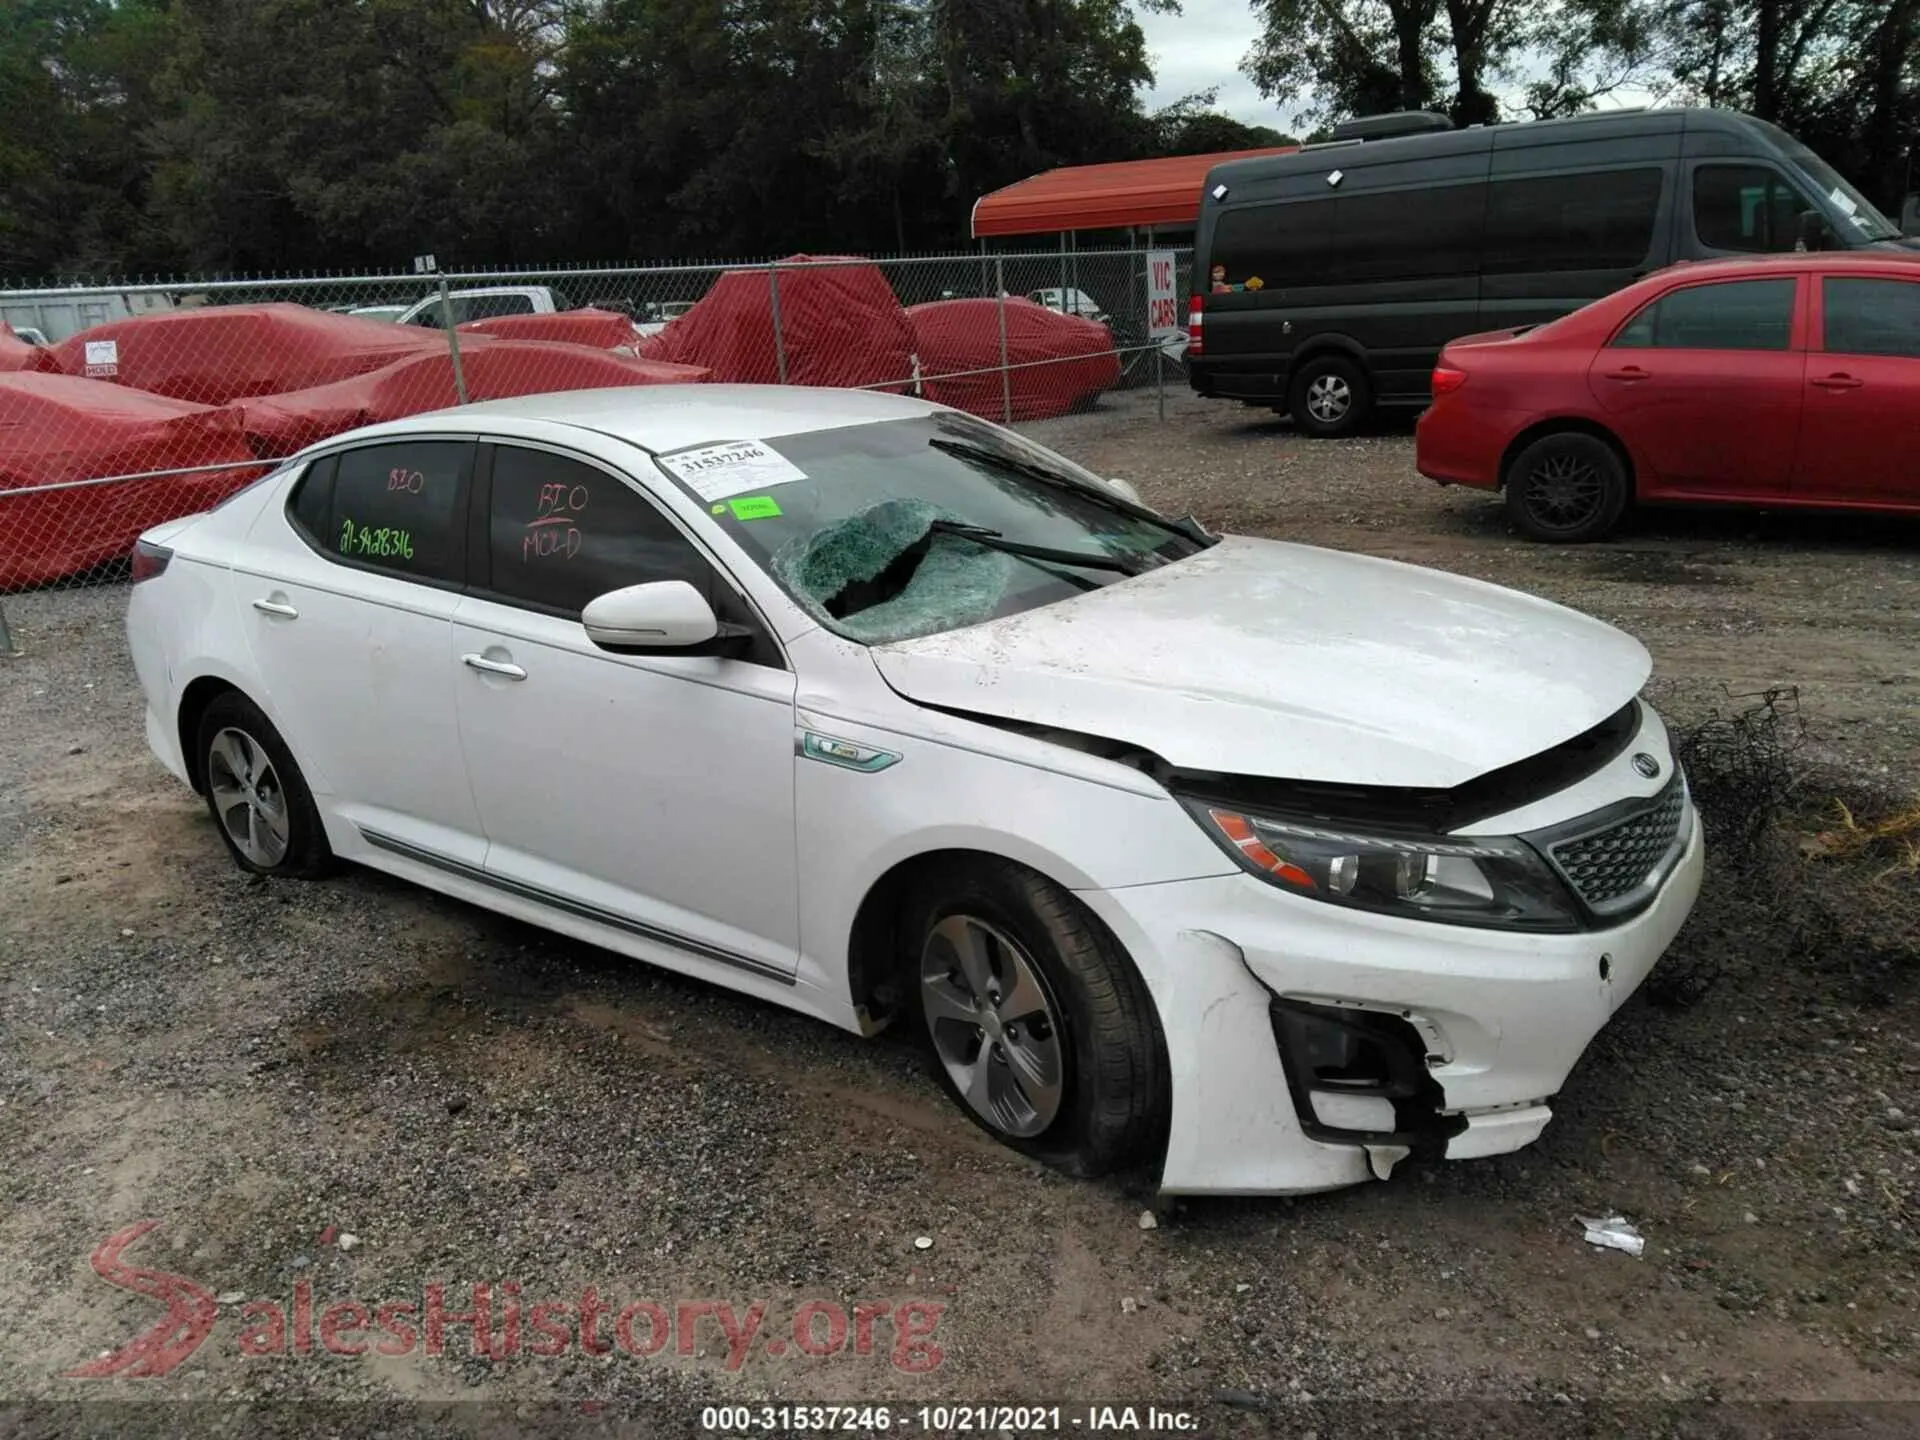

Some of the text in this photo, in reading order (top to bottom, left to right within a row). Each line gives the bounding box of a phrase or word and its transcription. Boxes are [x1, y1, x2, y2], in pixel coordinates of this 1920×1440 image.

[1152, 261, 1171, 291] VIC
[1151, 298, 1176, 329] CARS
[681, 448, 764, 473] 31537246
[538, 483, 588, 512] BIO
[523, 527, 582, 564] MOLD
